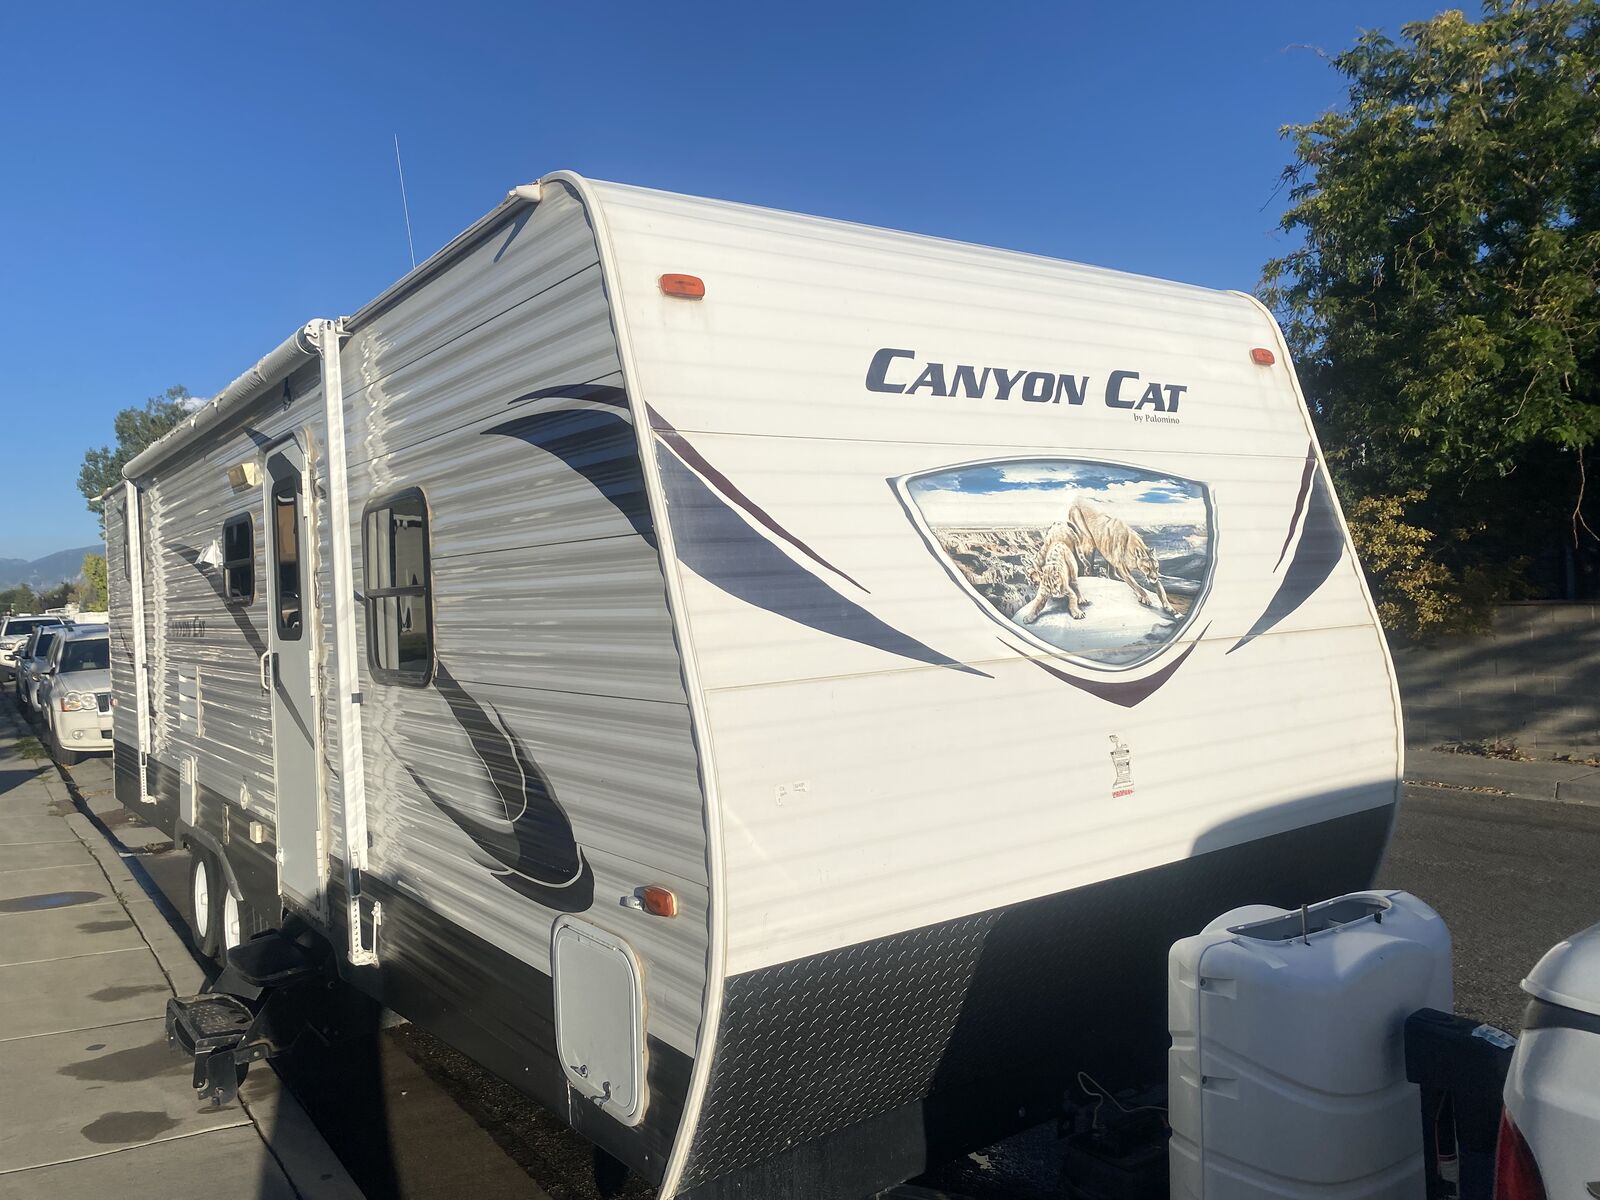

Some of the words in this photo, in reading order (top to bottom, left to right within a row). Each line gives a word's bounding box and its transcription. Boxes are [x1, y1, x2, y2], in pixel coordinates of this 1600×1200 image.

[865, 348, 1090, 406] CANYON
[1104, 370, 1188, 413] CAT
[1133, 412, 1144, 423] by
[1145, 414, 1180, 424] Palomino
